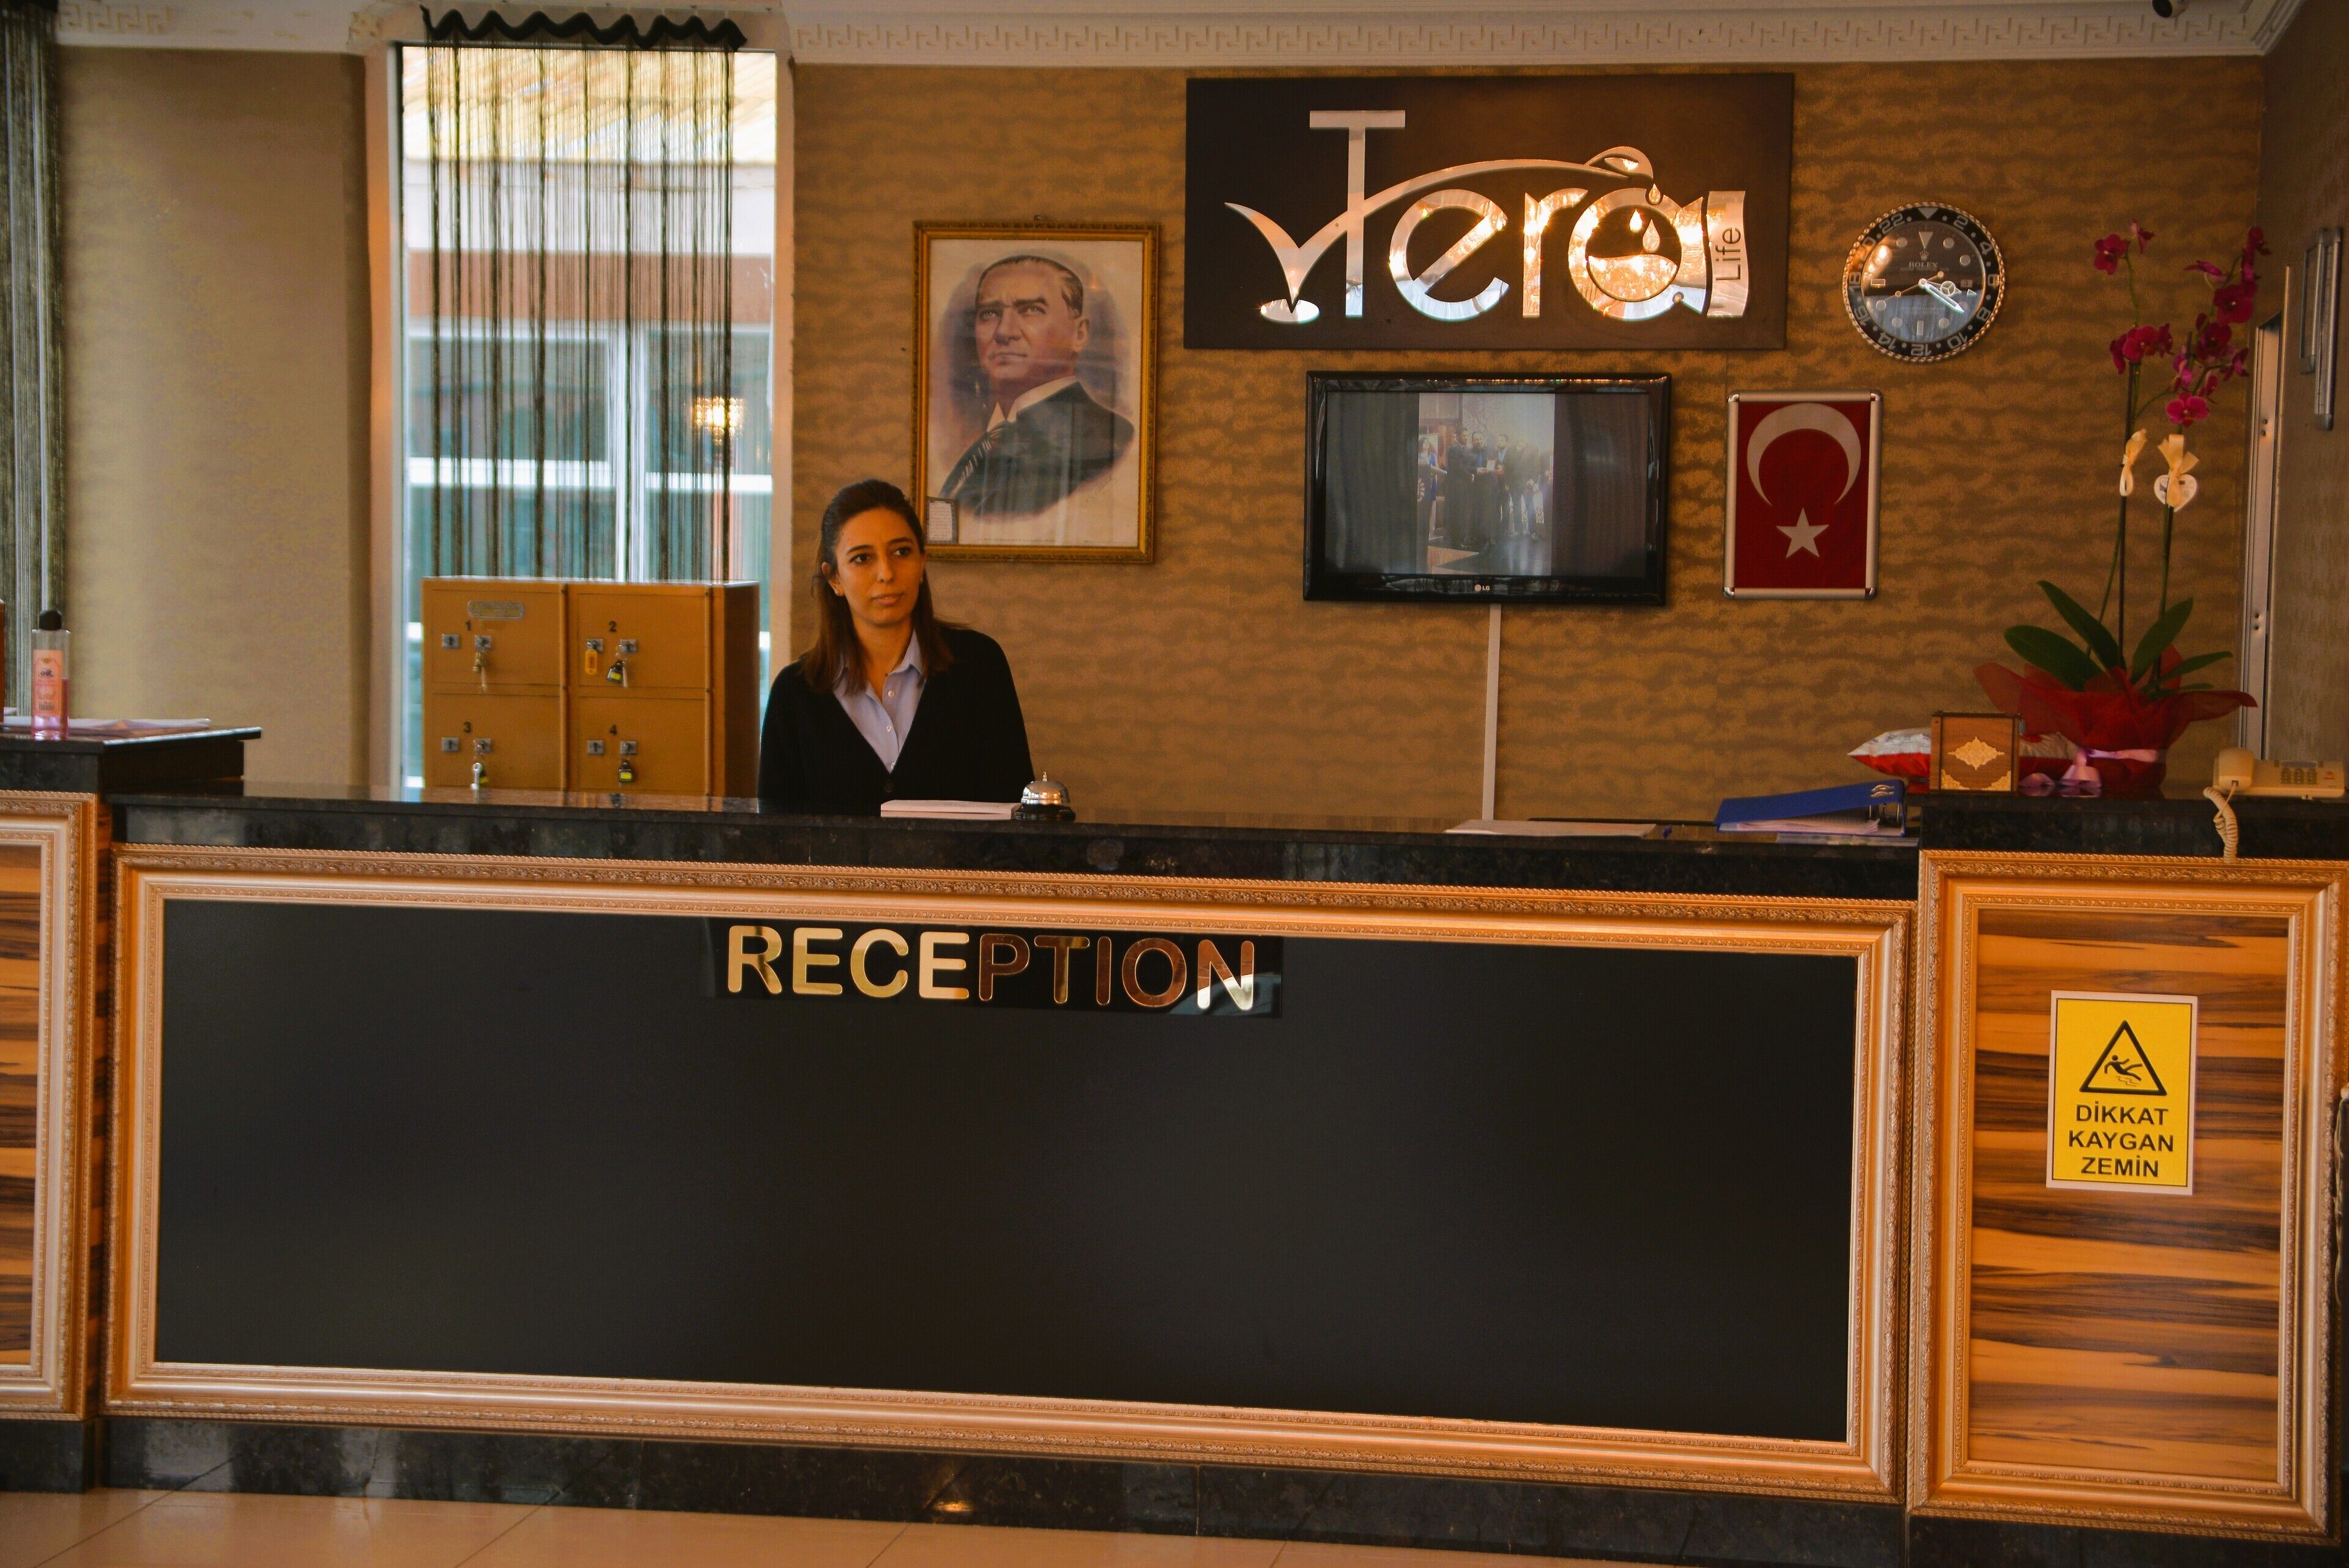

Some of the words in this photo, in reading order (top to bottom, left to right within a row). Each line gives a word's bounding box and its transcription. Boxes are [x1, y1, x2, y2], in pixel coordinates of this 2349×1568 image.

[1310, 110, 1709, 321] Tera
[1715, 227, 1741, 280] Life
[1880, 213, 1905, 234] 22
[1953, 215, 1969, 229] 2
[1878, 332, 1896, 349] 14
[1947, 332, 1967, 349] 10
[1911, 344, 1931, 356] 12
[466, 620, 471, 631] 1
[609, 620, 617, 632] 2
[463, 721, 472, 733] 3
[610, 724, 617, 735] 4
[728, 926, 1254, 1011] RECEPTION
[2076, 1101, 2169, 1125] DİKKAT
[2068, 1130, 2173, 1151] KAYGAN
[2080, 1155, 2158, 1177] ZEMİN
